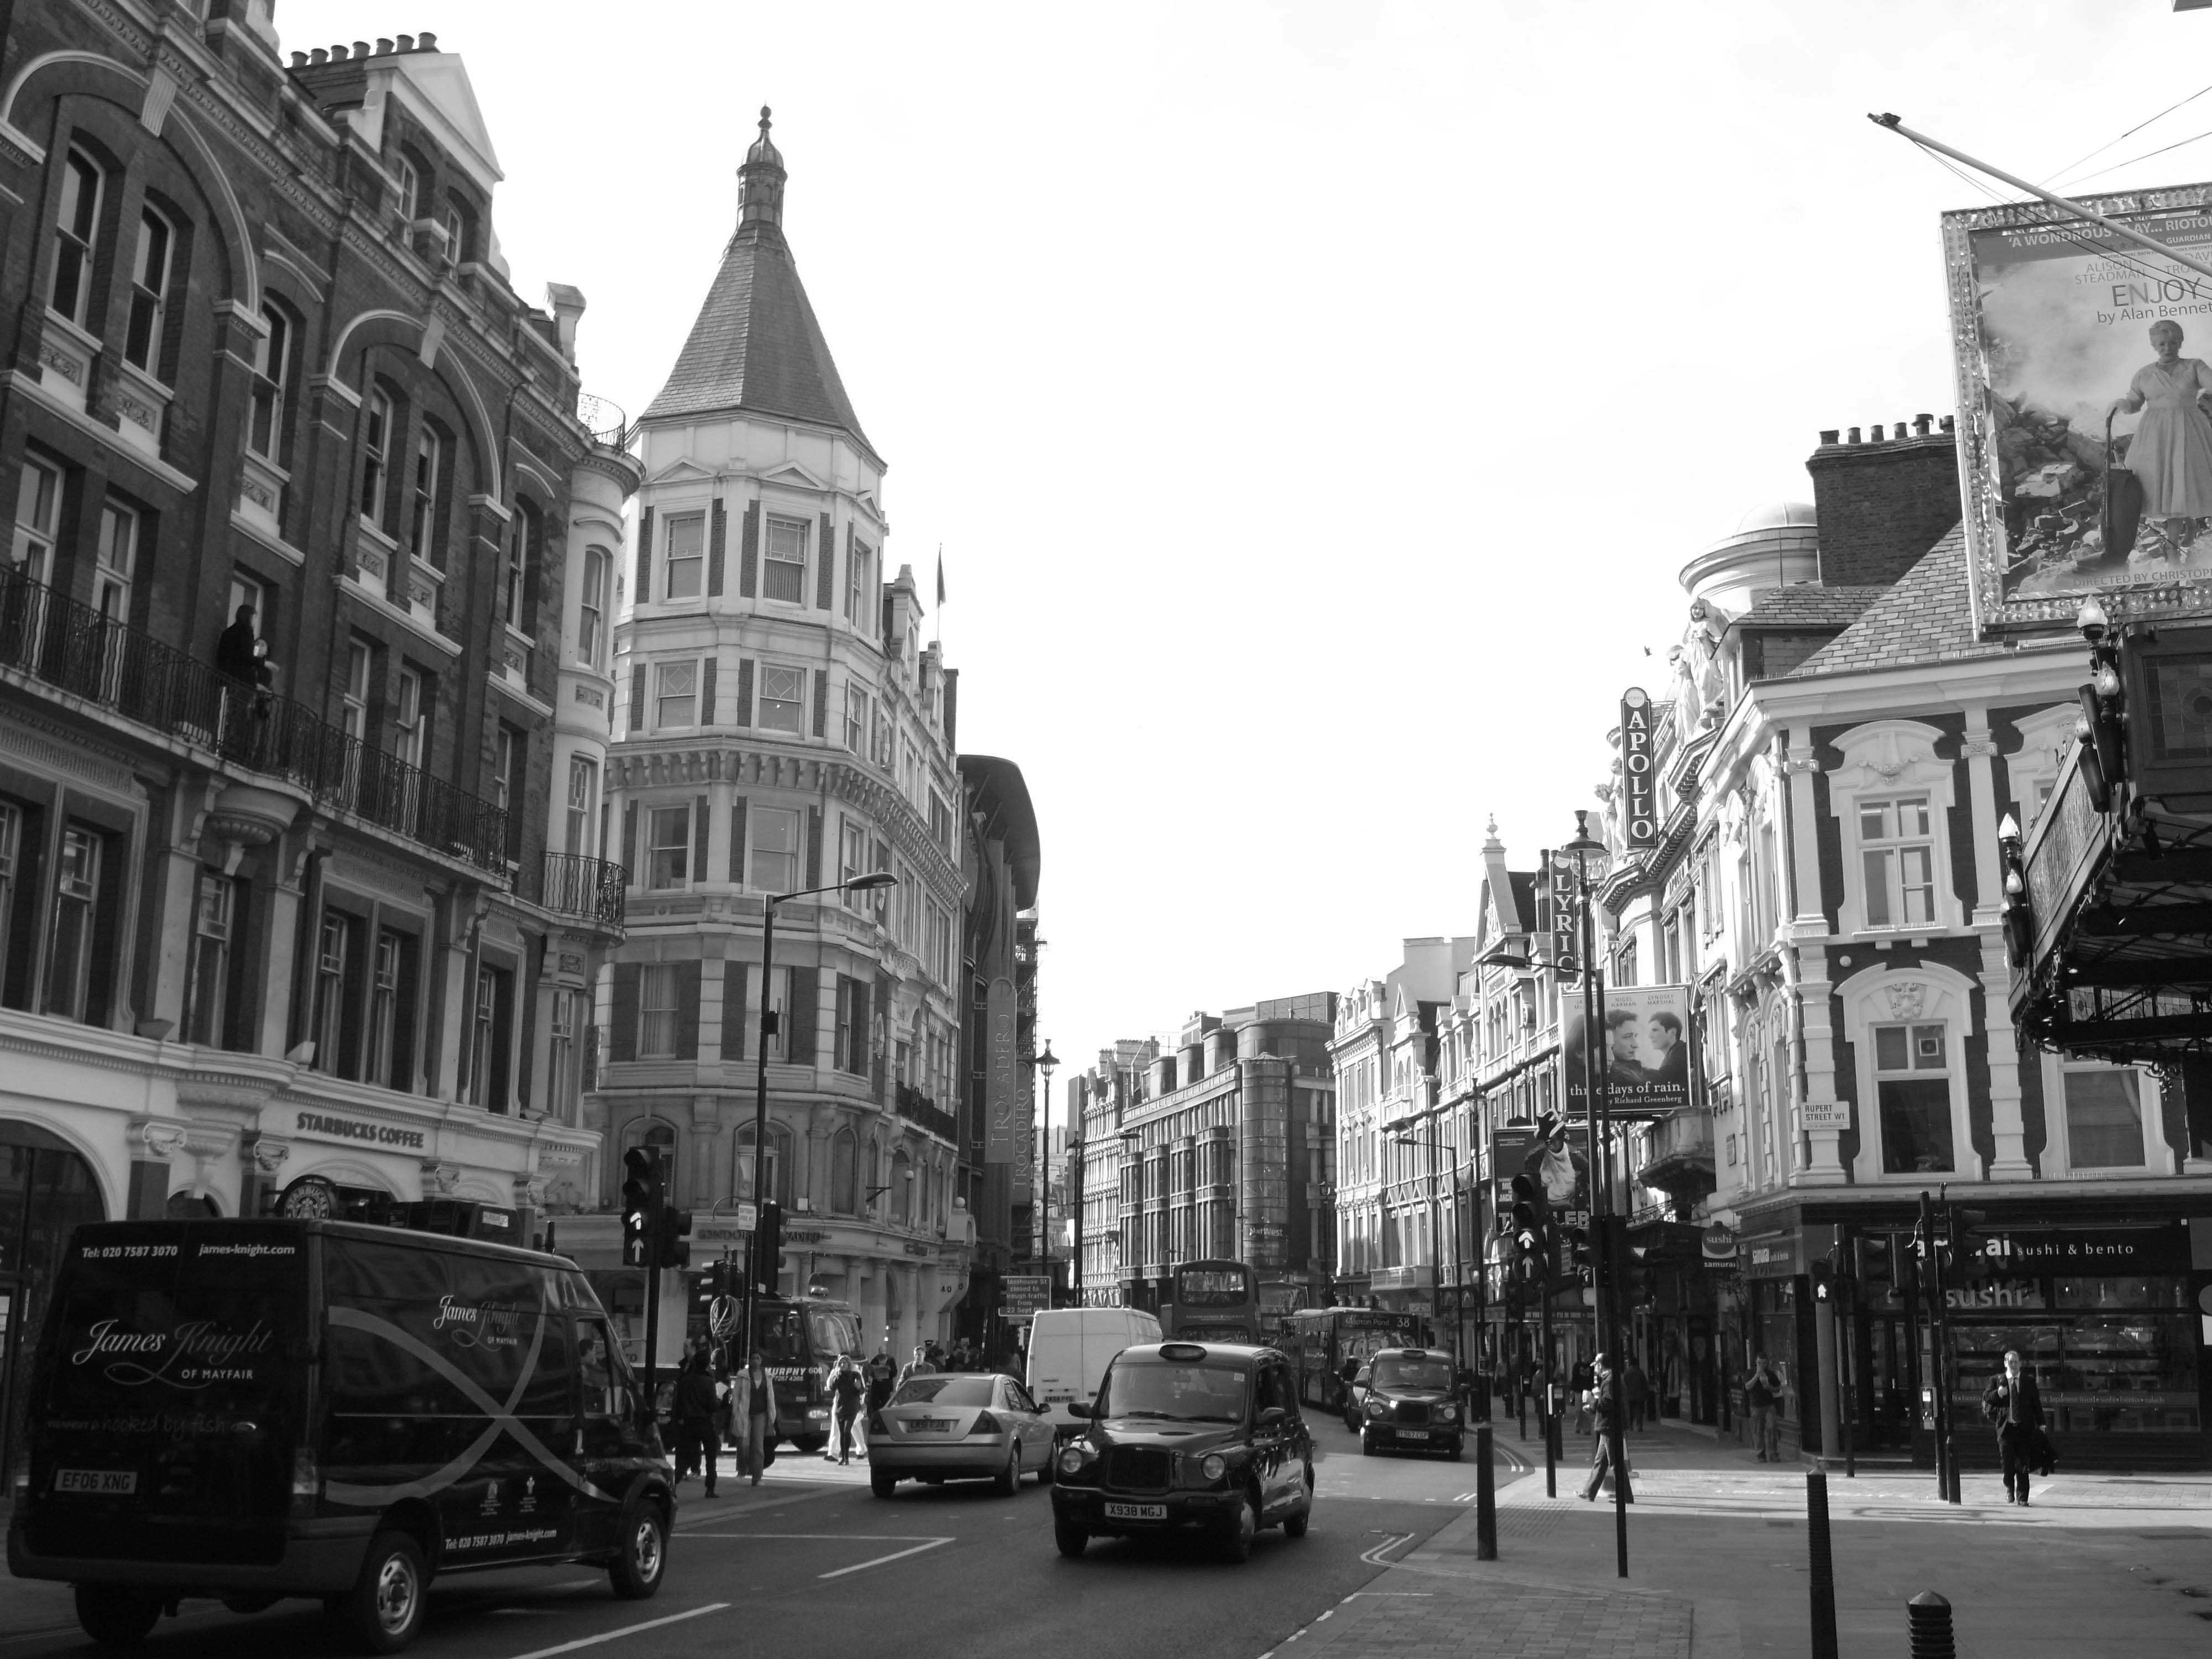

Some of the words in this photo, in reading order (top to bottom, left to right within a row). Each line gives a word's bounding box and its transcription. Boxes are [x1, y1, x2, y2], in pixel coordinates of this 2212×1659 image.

[2024, 228, 2112, 244] WONDROUS
[2166, 233, 2211, 244] GUARDIAN
[2086, 260, 2132, 273] ALISON
[2075, 268, 2145, 284] STEADMAN
[2112, 278, 2201, 307] ENJOY
[2097, 311, 2115, 325] by
[2121, 307, 2154, 321] Alan
[2074, 575, 2130, 587] DIRECTED
[2134, 573, 2148, 582] BY
[1627, 711, 1653, 839] APOLLO
[1555, 875, 1575, 973] LYRIC
[991, 1014, 1011, 1146] TROCADERO
[1570, 1084, 1601, 1096] thre
[1608, 1082, 1632, 1098] days
[1636, 1081, 1651, 1093] of
[1654, 1081, 1685, 1093] rain.
[1614, 1095, 1641, 1104] Richard
[1644, 1095, 1682, 1104] Greenberg
[298, 1113, 377, 1141] STARBUCKS
[379, 1126, 424, 1148] COFFEE
[1013, 1089, 1030, 1190] TROCADERO
[1249, 1227, 1283, 1237] NatWest
[1707, 1233, 1731, 1244] sushi
[82, 1246, 100, 1259] Tel:
[102, 1246, 121, 1258] 020
[123, 1245, 149, 1257] 7587
[152, 1245, 178, 1257] 3070
[199, 1244, 296, 1258] james-knight.com
[2017, 1243, 2059, 1256] sushi
[2068, 1245, 2077, 1256] &
[2086, 1243, 2133, 1256] bento
[433, 1295, 478, 1329] James
[1396, 1317, 1410, 1328] 38
[71, 1318, 166, 1366] James
[174, 1318, 274, 1366] Knight
[181, 1368, 197, 1380] OF
[202, 1369, 254, 1380] MAYFAIR
[765, 1366, 806, 1376] MURPHY
[62, 1472, 98, 1489] EF06
[102, 1474, 131, 1491] XNG
[1110, 1505, 1137, 1517] X938
[1140, 1506, 1162, 1517] MGJ
